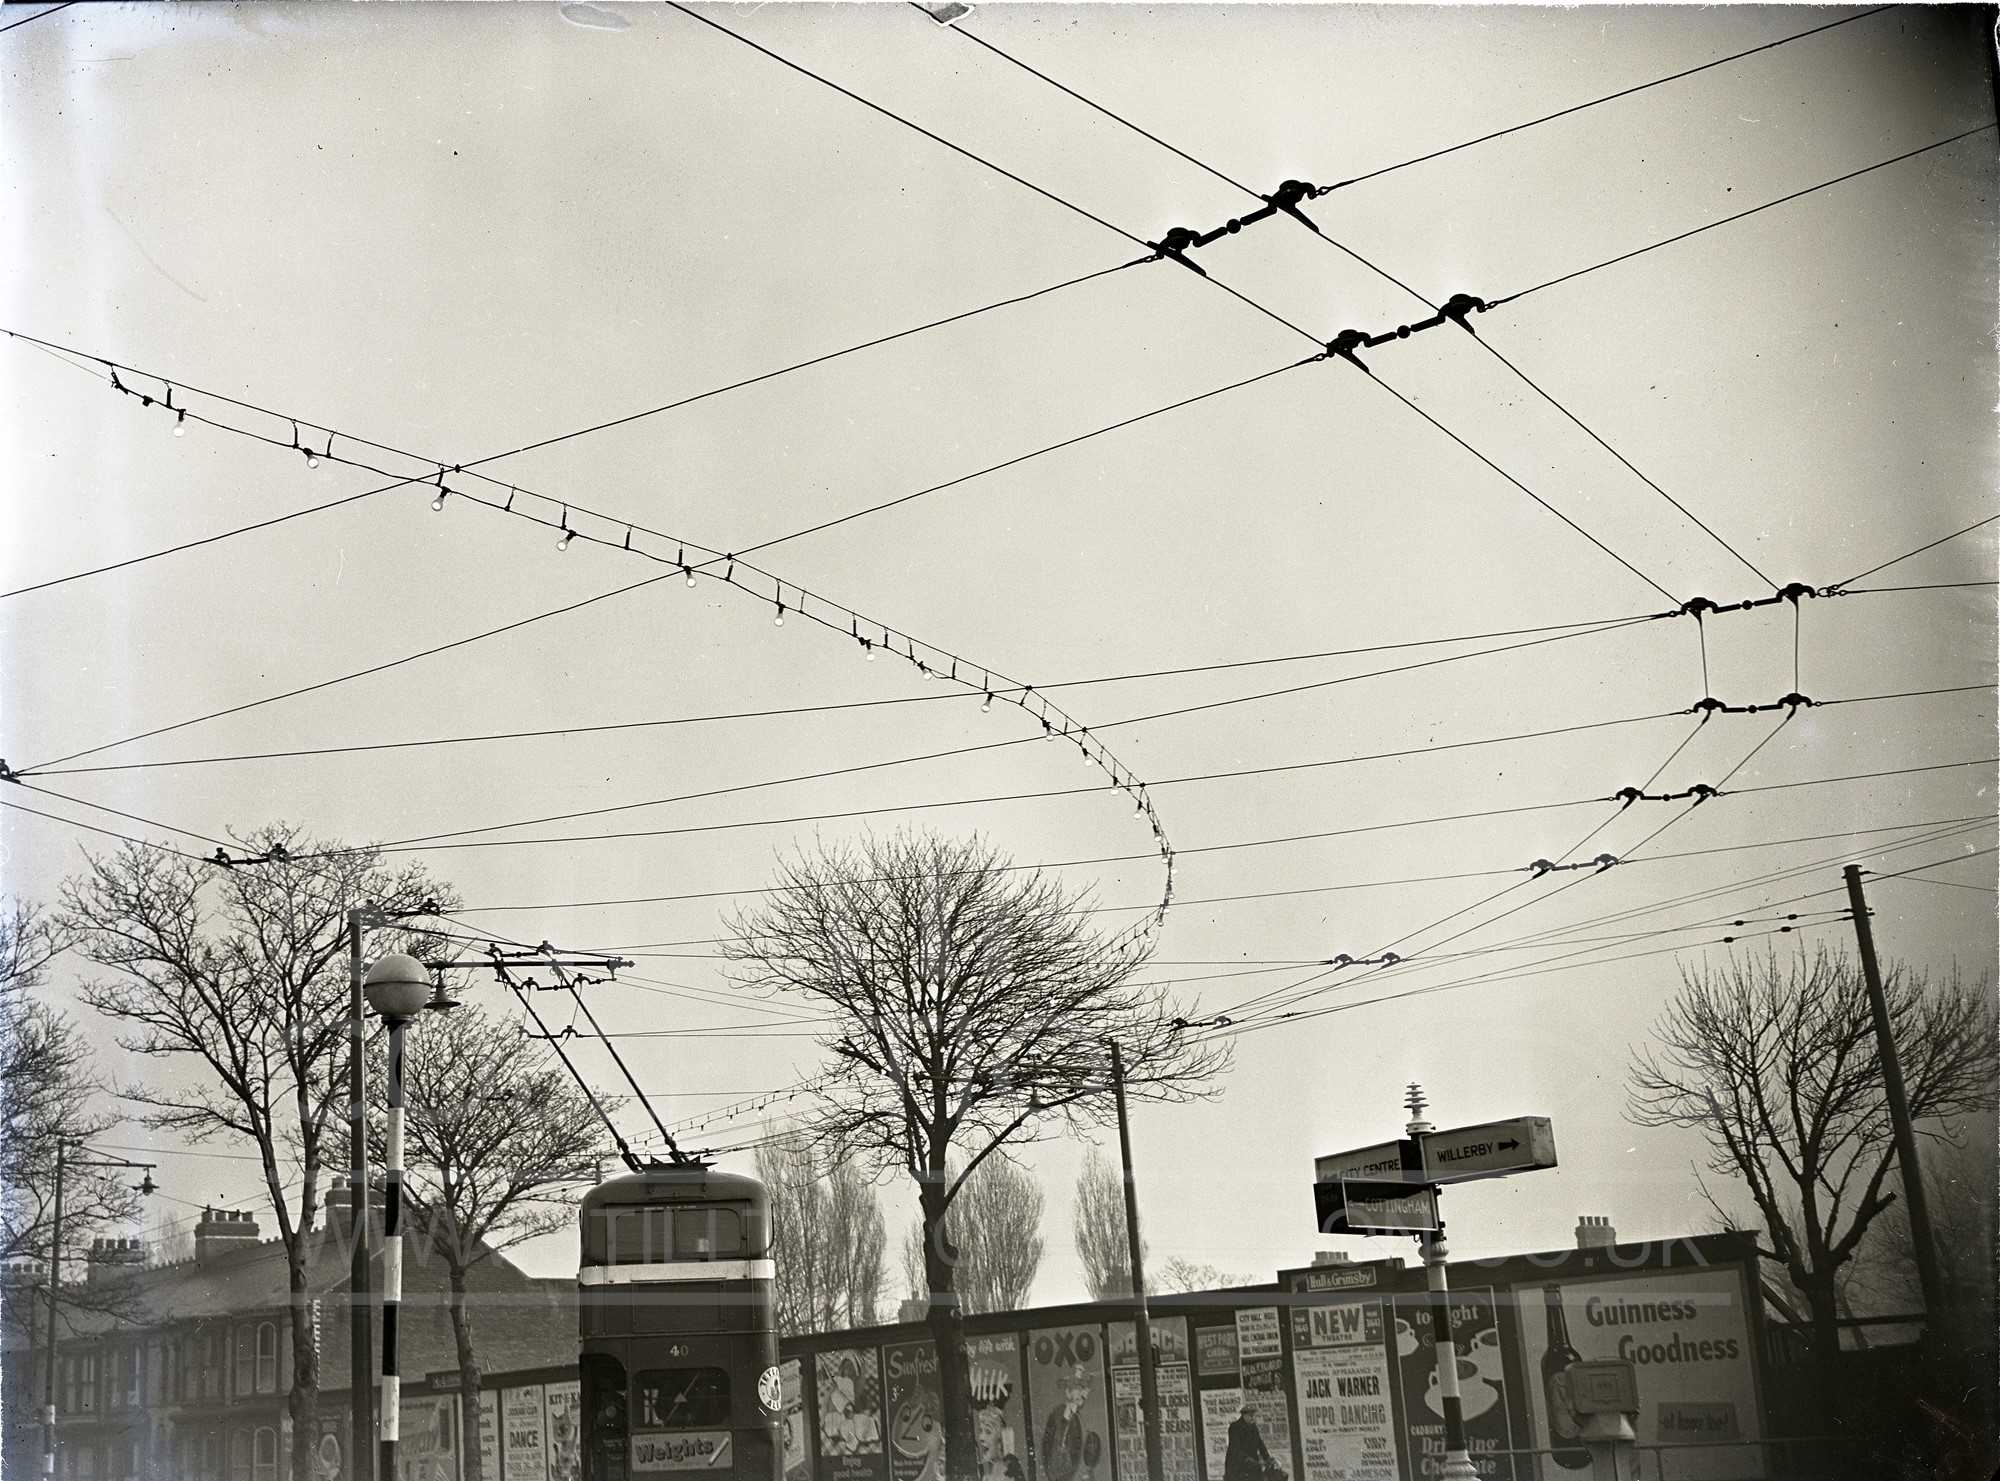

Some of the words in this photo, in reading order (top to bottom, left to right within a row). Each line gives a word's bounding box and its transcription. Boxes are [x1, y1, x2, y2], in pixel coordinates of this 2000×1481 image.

[1437, 1141, 1494, 1163] WILLERBY
[1363, 1158, 1401, 1176] CENTRE
[1365, 1198, 1432, 1216] COTTINGHAM
[1314, 1308, 1360, 1335] NEW
[1586, 1296, 1697, 1327] Guinness
[670, 1344, 689, 1357] 40
[1035, 1331, 1096, 1367] OXO
[1618, 1333, 1739, 1366] Goodness
[1306, 1378, 1332, 1399] JACK
[1337, 1375, 1380, 1397] WARNER
[1305, 1405, 1336, 1426] HIPPO
[1340, 1403, 1387, 1425] DANCING
[510, 1430, 539, 1449] DANCE
[1422, 1437, 1499, 1457] Driing
[635, 1437, 715, 1465] Weights
[1420, 1457, 1497, 1476] Choate
